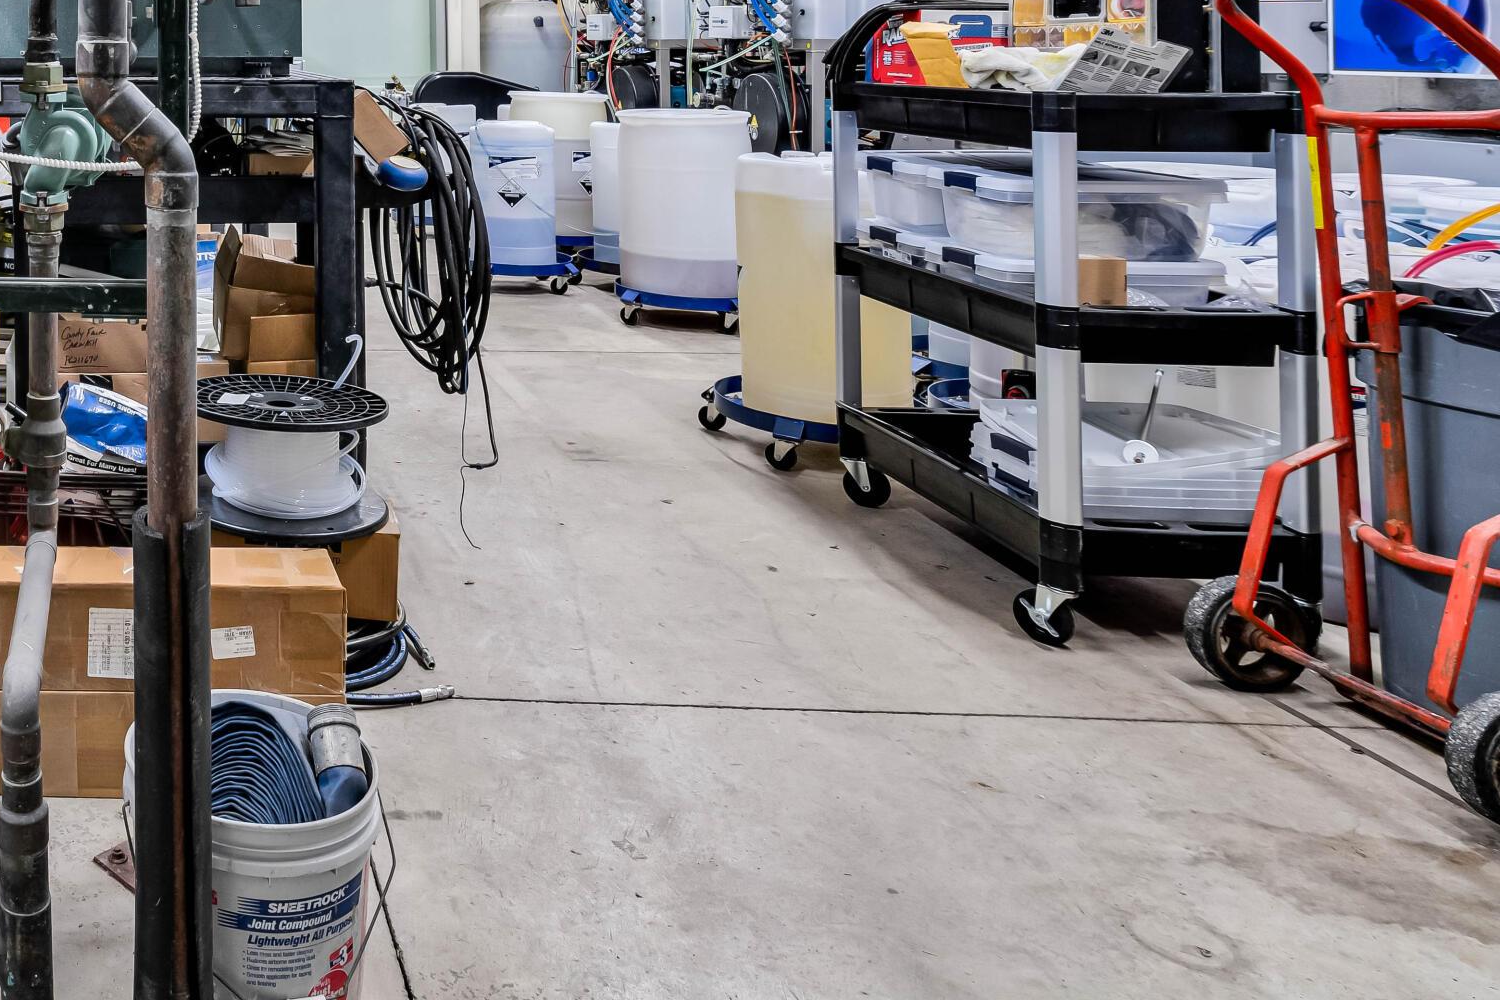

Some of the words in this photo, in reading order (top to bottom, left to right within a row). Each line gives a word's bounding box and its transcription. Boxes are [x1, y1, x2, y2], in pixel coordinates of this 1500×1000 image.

[1100, 29, 1114, 37] 3M
[67, 453, 86, 465] Great
[99, 461, 117, 471] Many
[118, 464, 137, 473] Uses!
[267, 886, 347, 914] SHEETROCK
[247, 918, 277, 931] Joint
[278, 910, 333, 931] Compound
[247, 933, 310, 947] Lightweight
[312, 929, 325, 941] All
